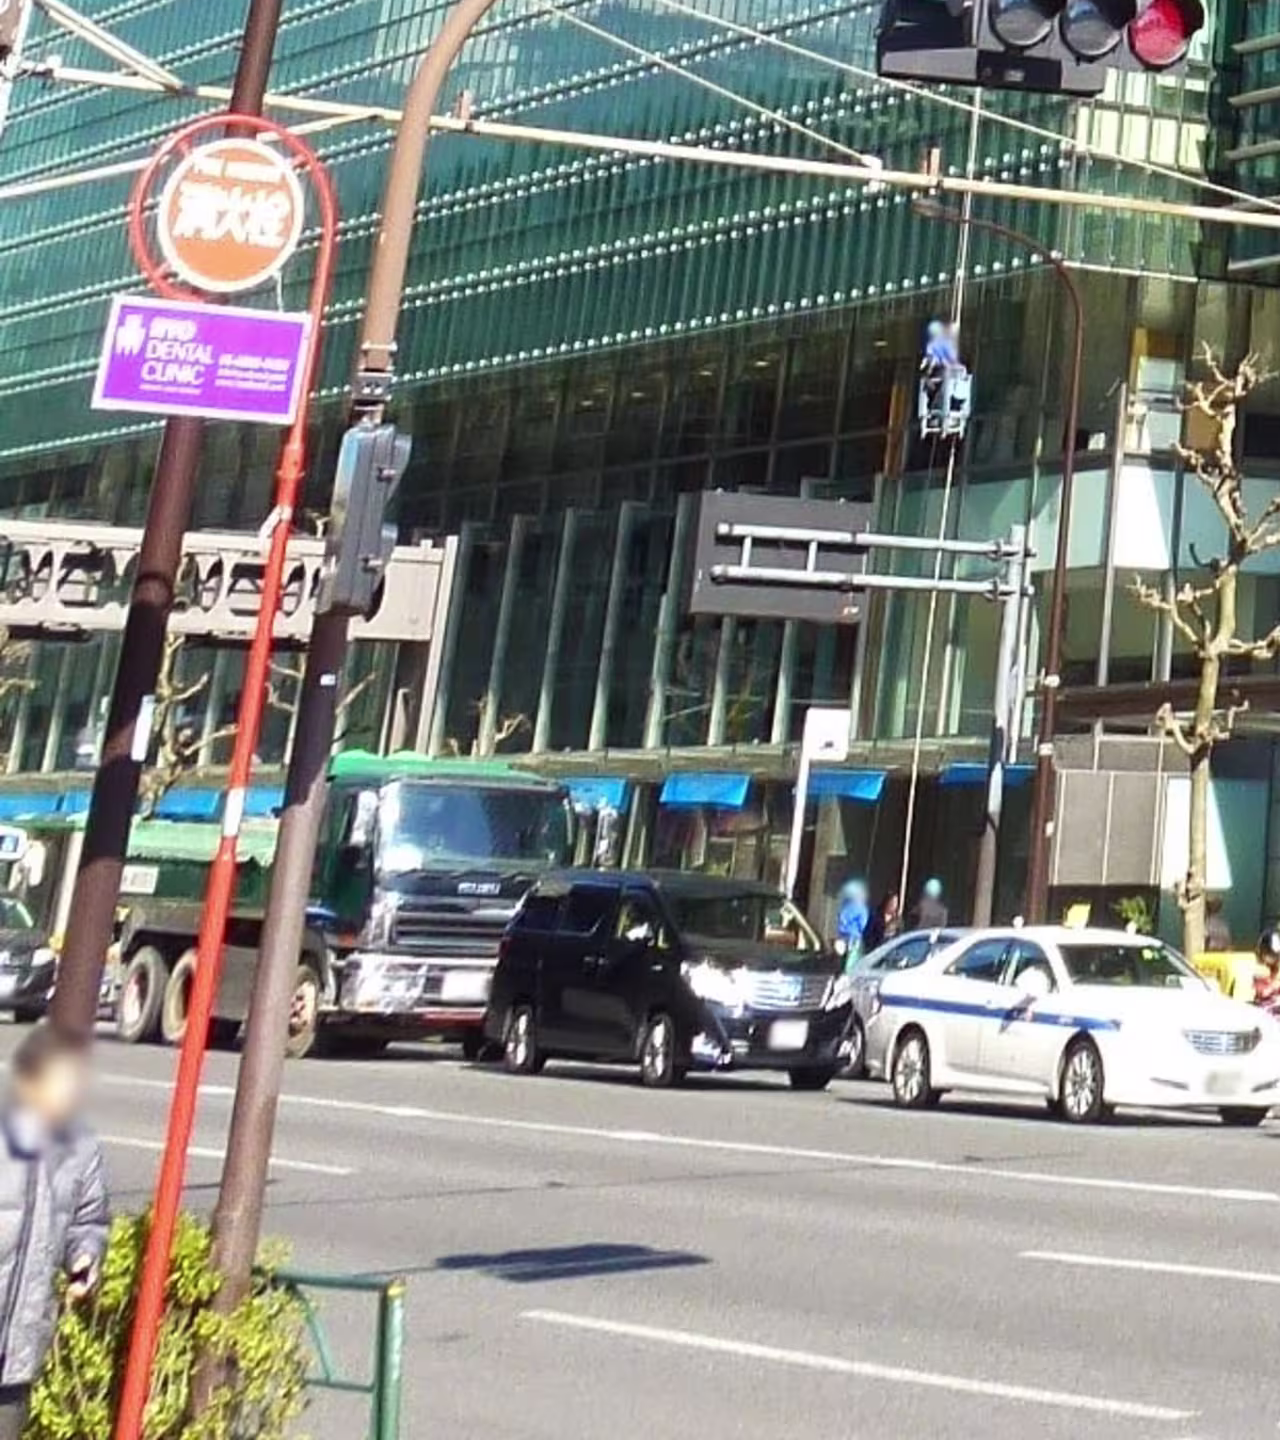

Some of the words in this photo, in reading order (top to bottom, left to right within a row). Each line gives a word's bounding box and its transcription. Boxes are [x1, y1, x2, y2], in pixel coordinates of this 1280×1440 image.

[145, 340, 213, 363] DENTAL
[141, 361, 205, 385] CLINIC
[457, 882, 501, 895] ISUZU
